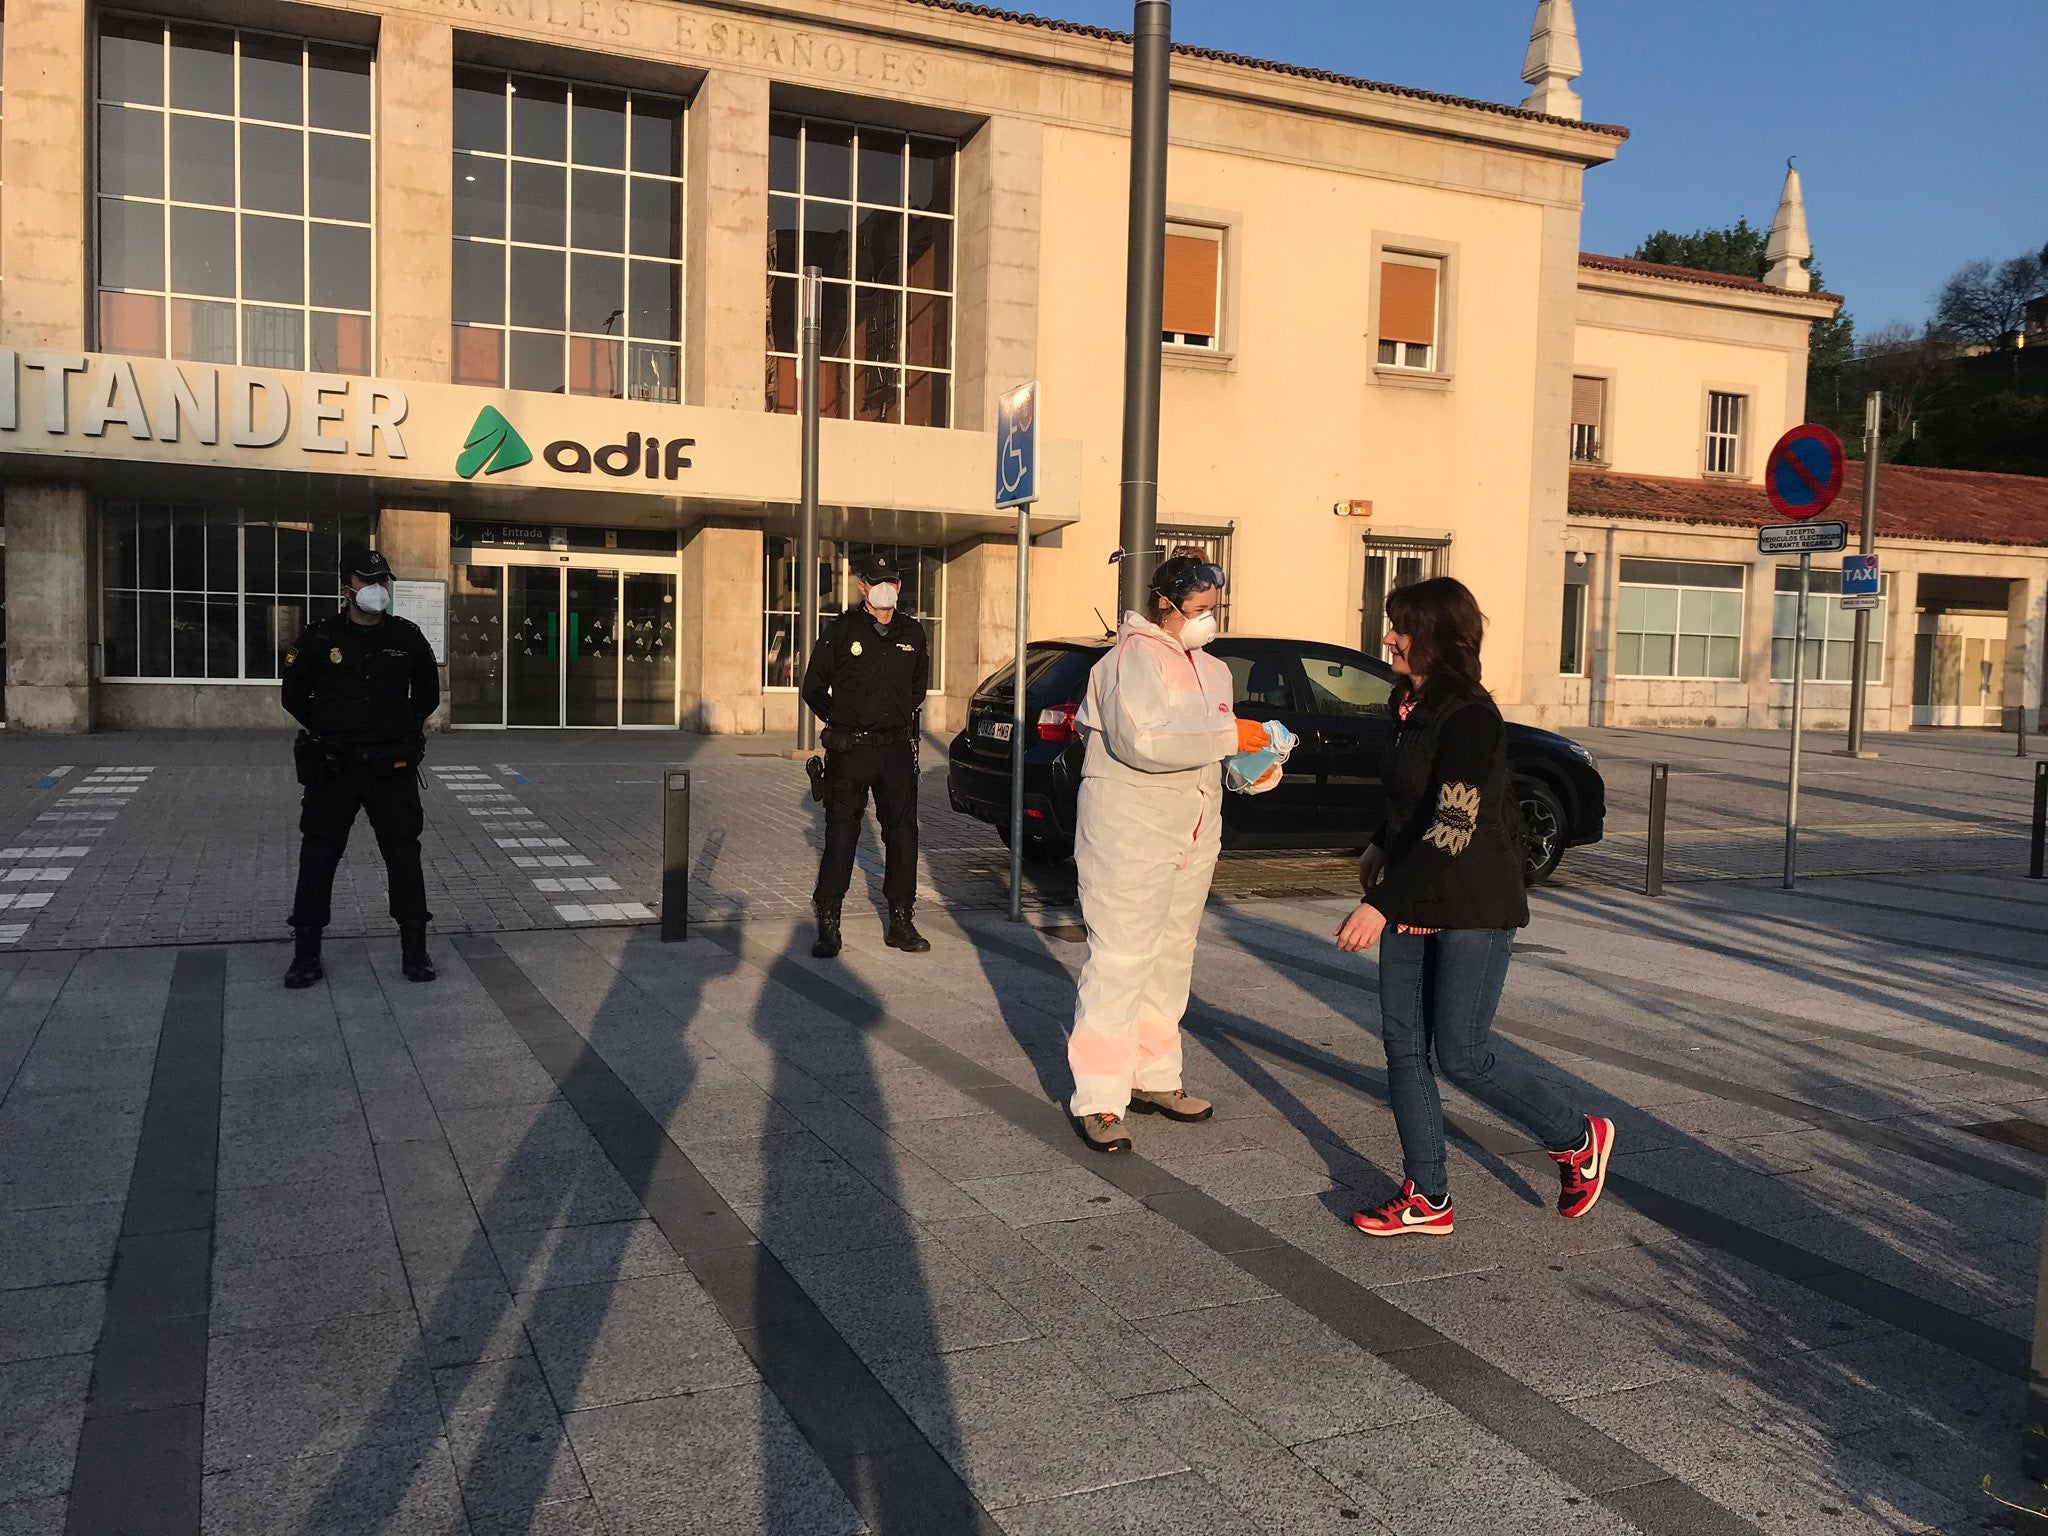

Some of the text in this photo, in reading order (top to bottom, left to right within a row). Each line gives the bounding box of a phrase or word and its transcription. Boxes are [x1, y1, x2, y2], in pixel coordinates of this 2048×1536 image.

[674, 15, 928, 86] ESPAÑOLES
[543, 431, 696, 480] adif
[502, 527, 543, 538] Entrada
[1761, 535, 1797, 543] VEHICULOS
[1769, 541, 1800, 549] DURANTE
[1844, 567, 1877, 581] TAXI
